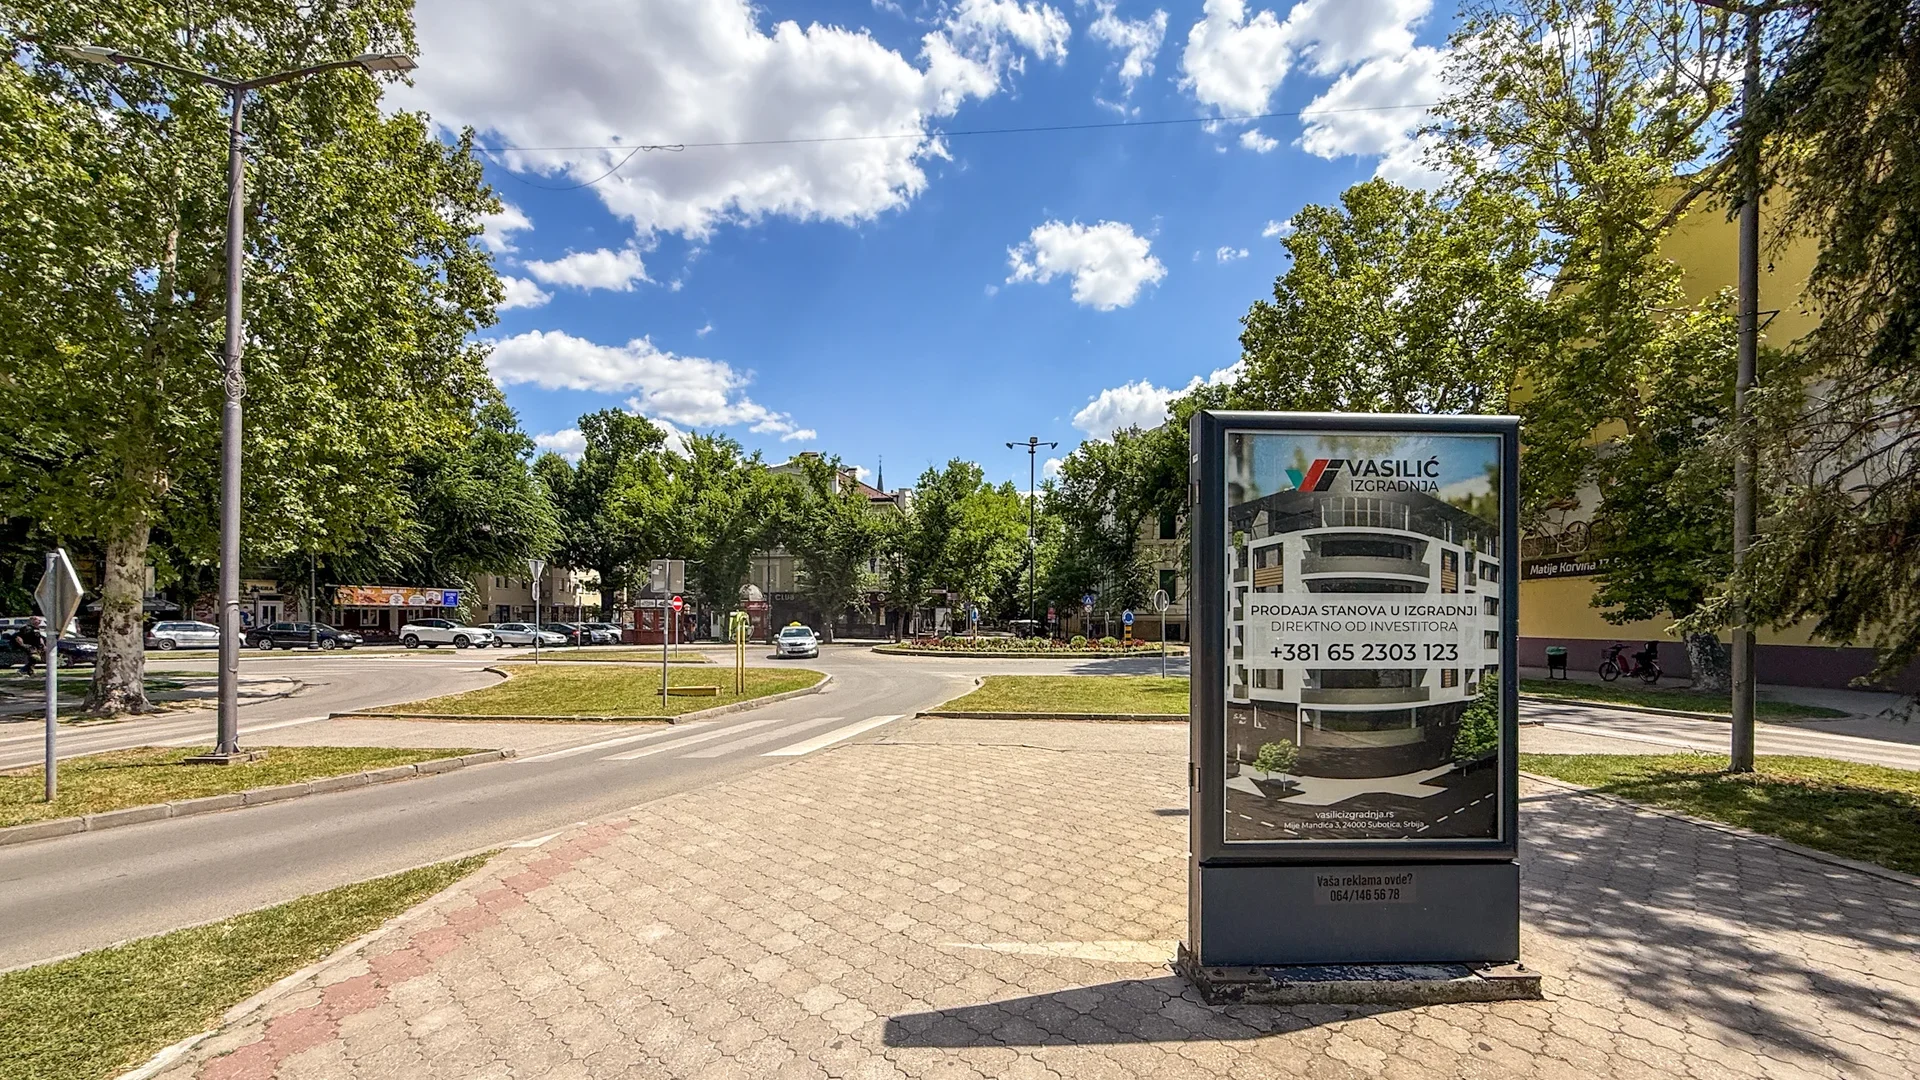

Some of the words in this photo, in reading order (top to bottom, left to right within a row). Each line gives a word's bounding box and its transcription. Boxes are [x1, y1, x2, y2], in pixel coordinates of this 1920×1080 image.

[1346, 455, 1440, 478] VASILIĆ
[1350, 479, 1439, 493] IZGRADNJA
[1530, 563, 1558, 576] Matije
[1250, 605, 1318, 617] PRODAJA
[1321, 605, 1386, 616] STANOVA
[1390, 605, 1400, 616] U
[1404, 605, 1477, 616] IZGRADNJI
[1271, 621, 1342, 632] DIREKTNO
[1345, 621, 1367, 632] OD
[1370, 621, 1458, 632] INVESTITORA
[1270, 643, 1319, 661] +381
[1327, 643, 1354, 661] 65
[1361, 643, 1416, 661] 2303
[1423, 643, 1459, 661] 123
[1315, 810, 1394, 820] vasilicizgradnja.rs
[1284, 822, 1300, 831] Mije
[1342, 820, 1366, 829] 24000
[1317, 874, 1341, 887] Vaša
[1342, 873, 1382, 886] reklama
[1384, 873, 1413, 886] ovde?
[1330, 889, 1372, 902] 064/146
[1374, 889, 1386, 901] 56
[1388, 888, 1400, 901] 78
